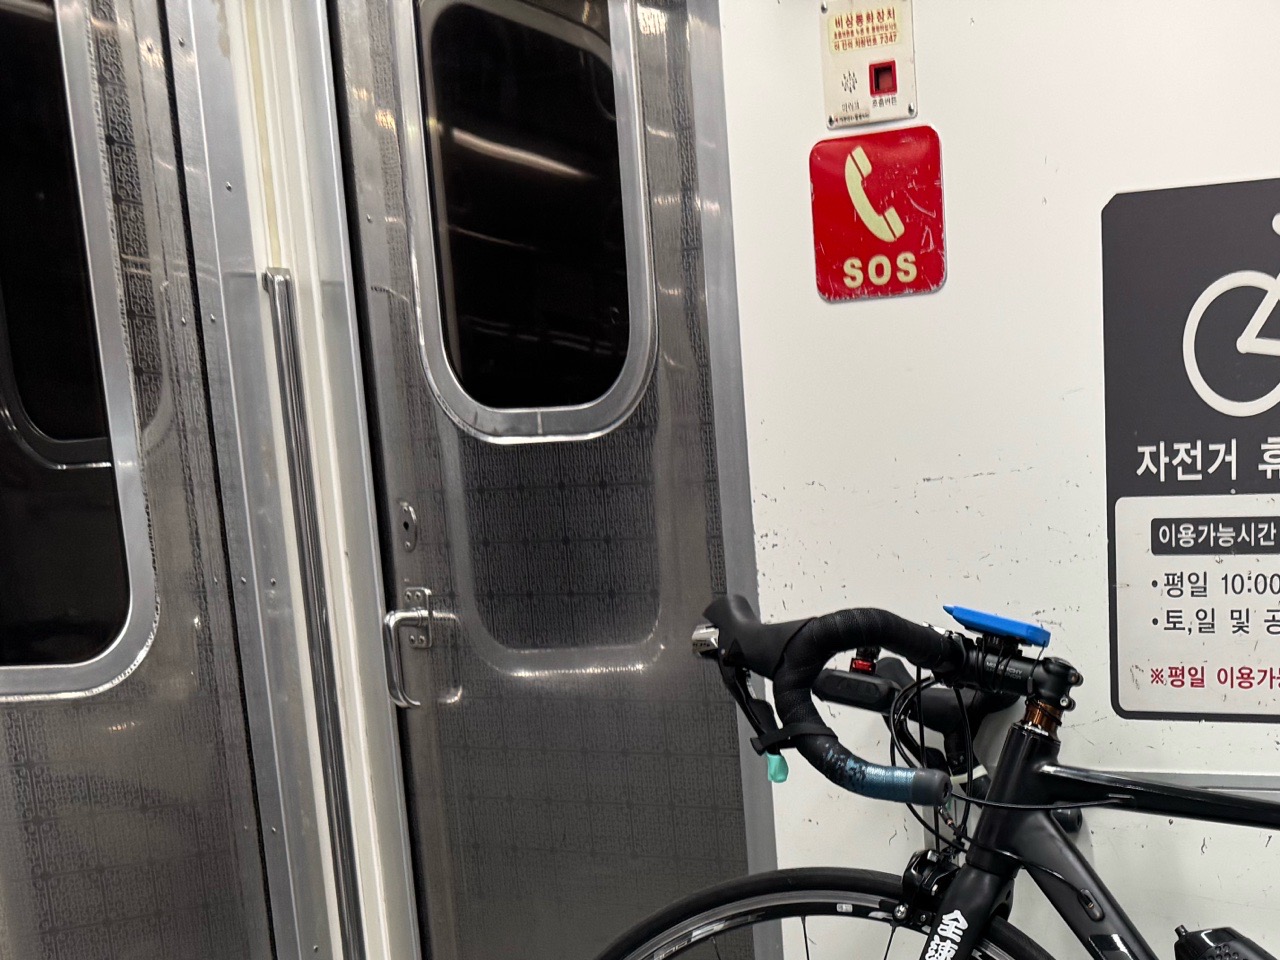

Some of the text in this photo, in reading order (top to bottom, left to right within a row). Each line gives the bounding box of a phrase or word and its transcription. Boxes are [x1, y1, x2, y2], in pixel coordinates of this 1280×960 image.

[834, 7, 896, 29] 비상통화장치
[880, 31, 897, 44] 7347
[843, 252, 918, 288] SOS
[1136, 439, 1239, 481] 자전거
[1158, 522, 1277, 548] 이용가능시간
[1163, 571, 1209, 598] 평일
[1230, 608, 1251, 634] 및
